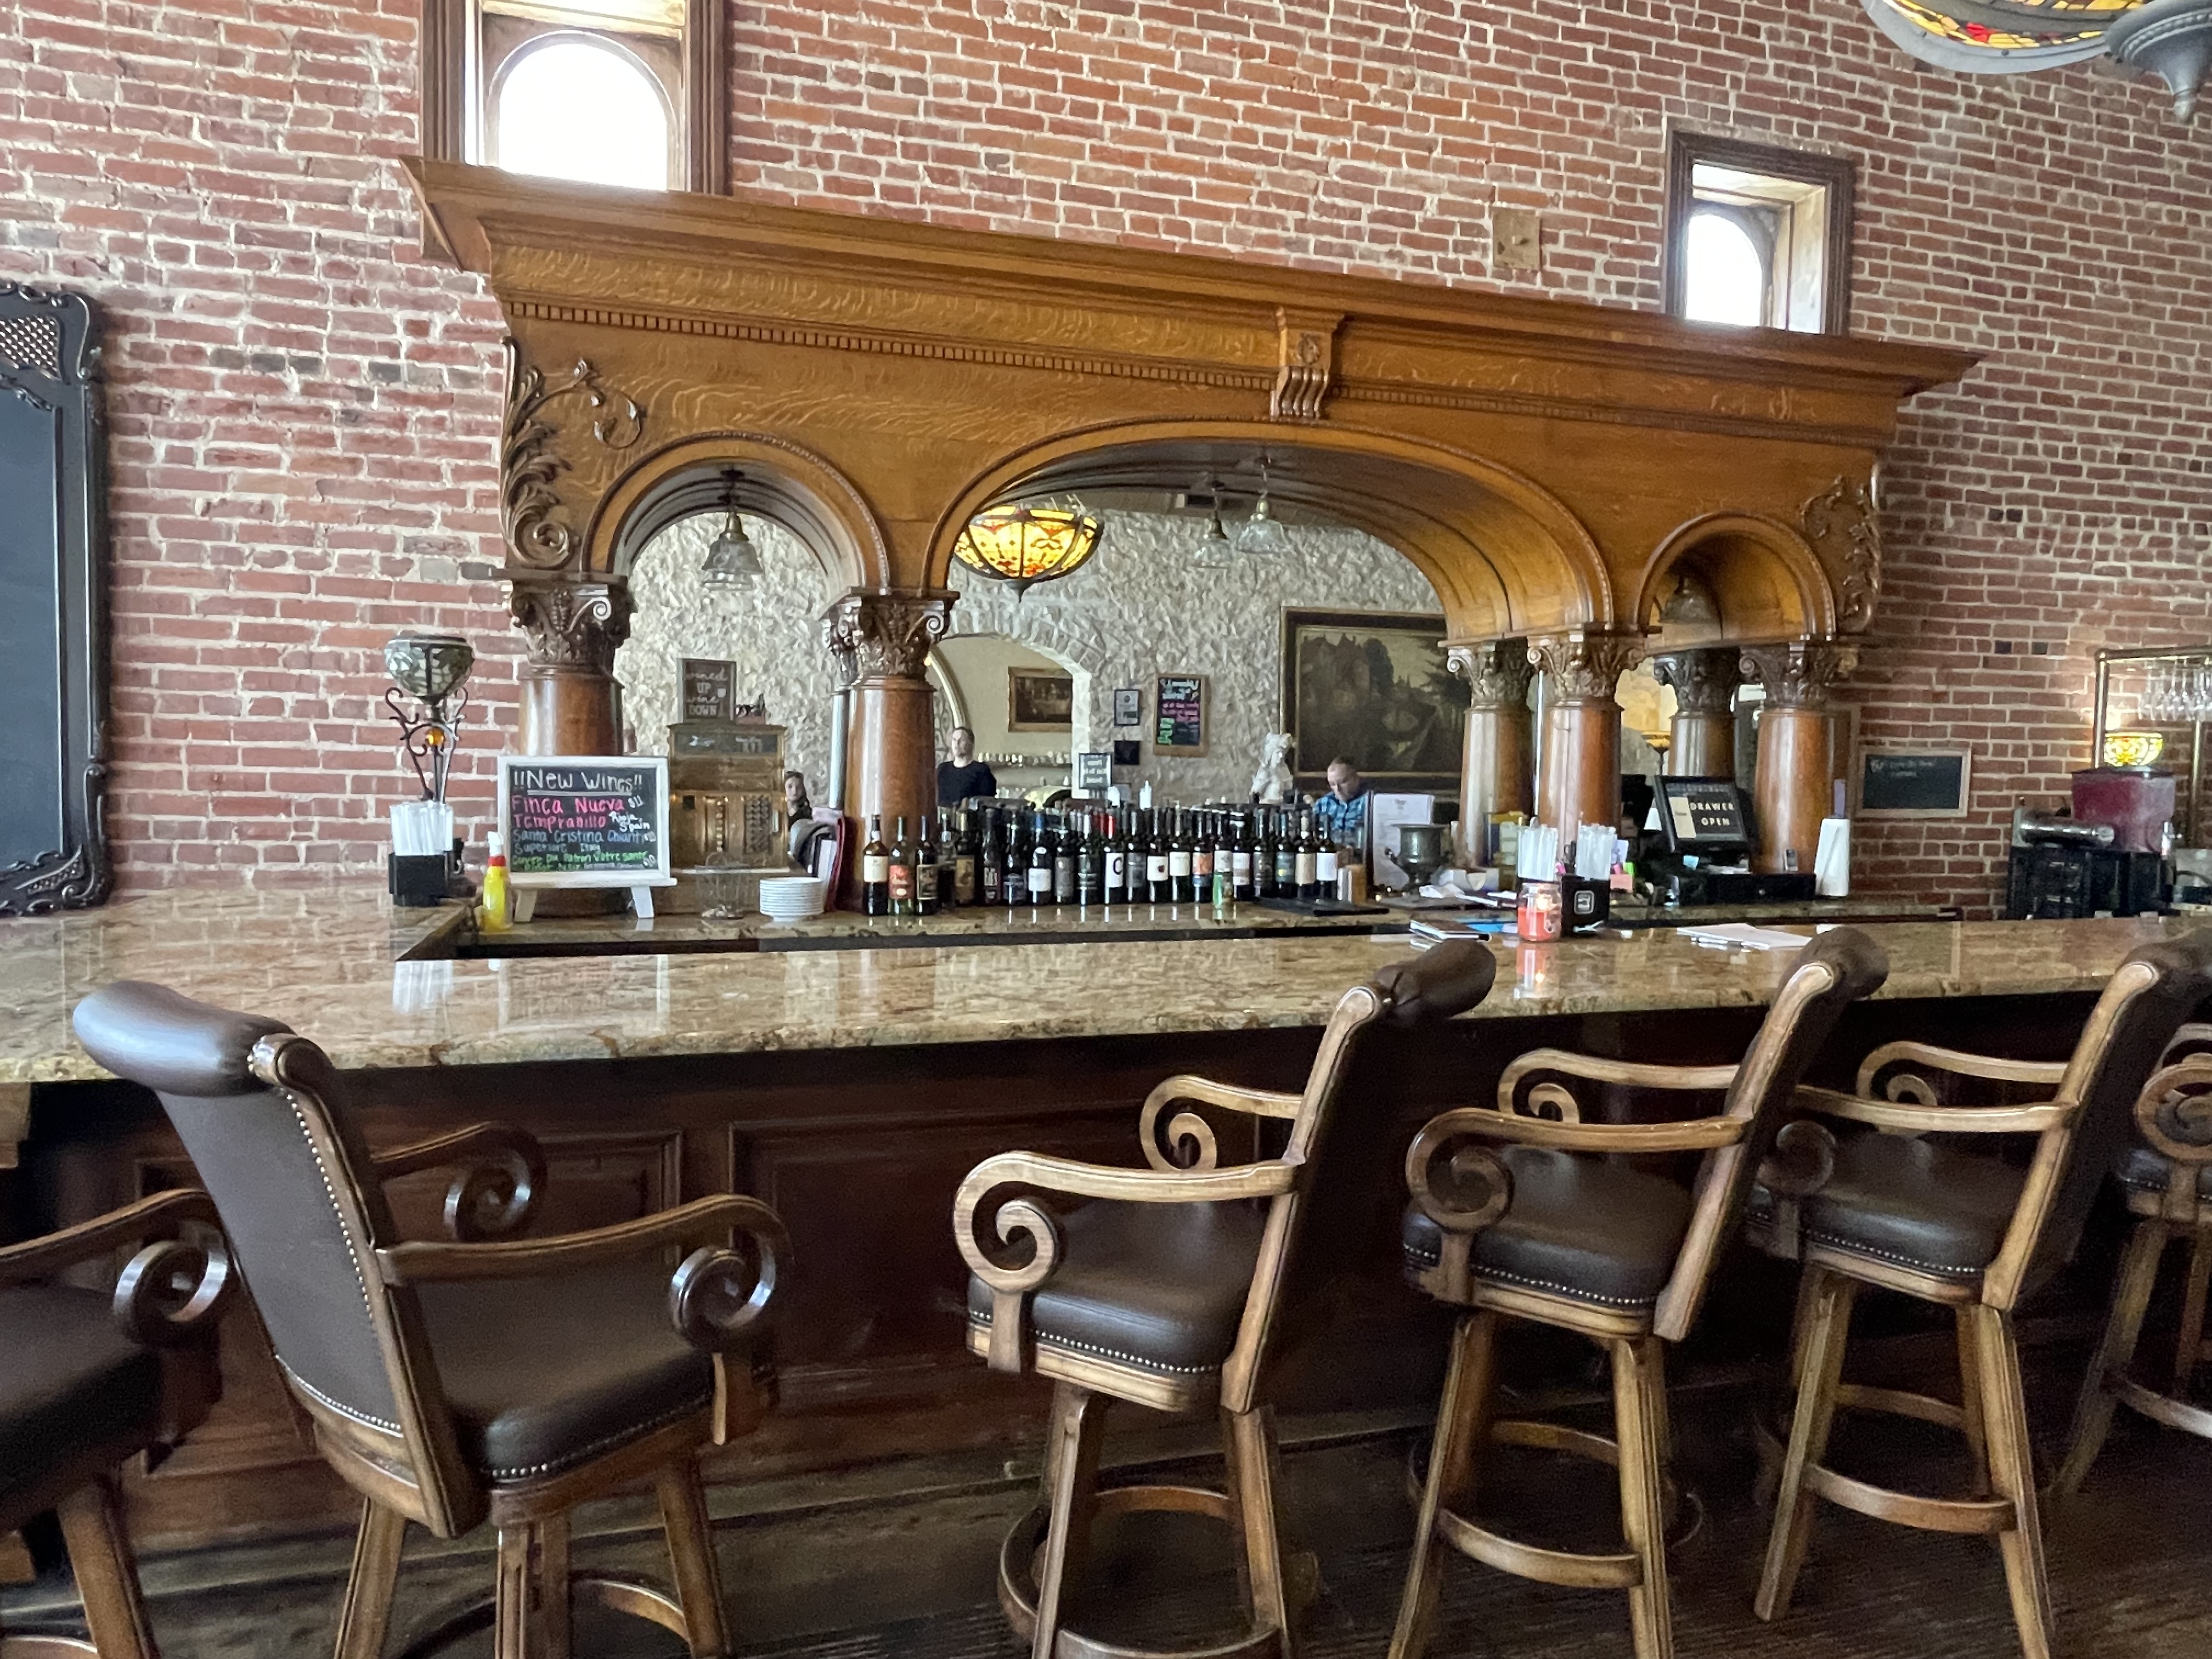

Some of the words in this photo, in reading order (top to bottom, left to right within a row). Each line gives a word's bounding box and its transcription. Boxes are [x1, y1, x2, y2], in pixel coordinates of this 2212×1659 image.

[697, 682, 711, 693] UP
[689, 704, 716, 715] DOWN
[511, 795, 564, 814] Finca
[1690, 802, 1735, 811] DRAWER
[1701, 817, 1730, 826] OPEN
[512, 829, 548, 843] Santa
[554, 829, 605, 843] Cristina
